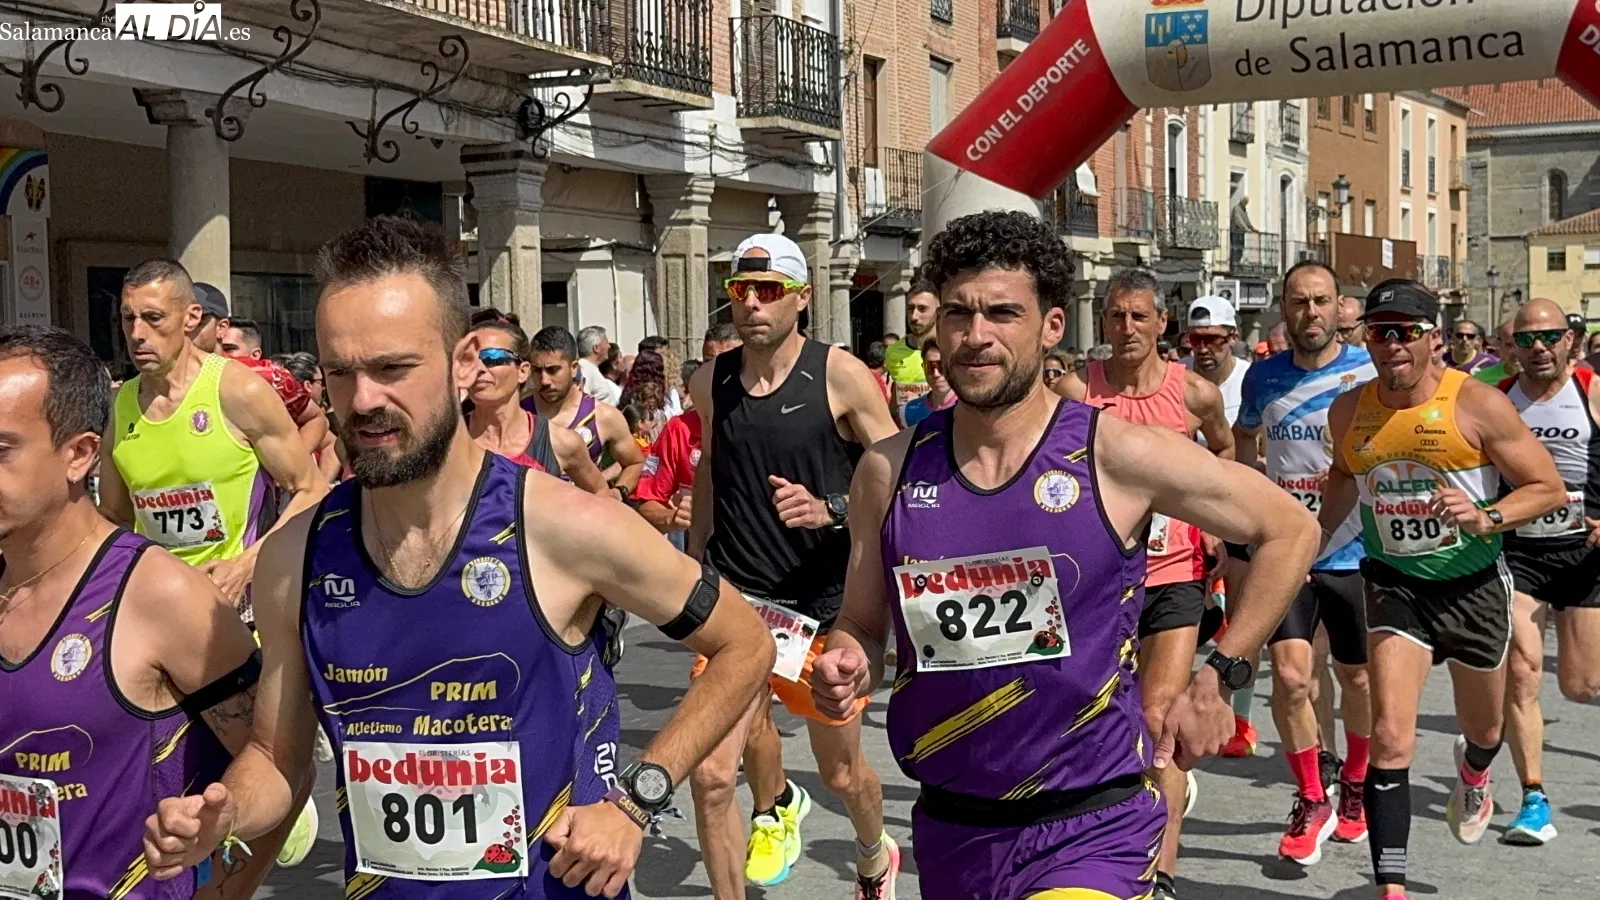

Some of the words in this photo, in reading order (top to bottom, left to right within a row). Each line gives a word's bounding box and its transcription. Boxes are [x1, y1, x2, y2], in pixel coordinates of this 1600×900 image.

[1235, 0, 1475, 29] Diputa
[1235, 49, 1272, 77] de
[1289, 30, 1525, 74] Salamanca
[966, 124, 1003, 162] CON
[997, 109, 1023, 132] EL
[1016, 38, 1091, 113] DEPORTE
[135, 488, 214, 510] bedunia
[153, 507, 204, 534] 773
[1390, 518, 1440, 541] 830
[900, 556, 1052, 600] bedunia
[936, 590, 1032, 641] 822
[323, 663, 388, 683] Jamón
[430, 680, 498, 702] PRIM
[346, 721, 402, 736] Atletismo
[413, 713, 512, 736] Macotera
[15, 751, 71, 772] PRIM
[348, 750, 517, 787] bedunia
[381, 794, 478, 845] 801
[619, 795, 649, 825] CASTILLA
